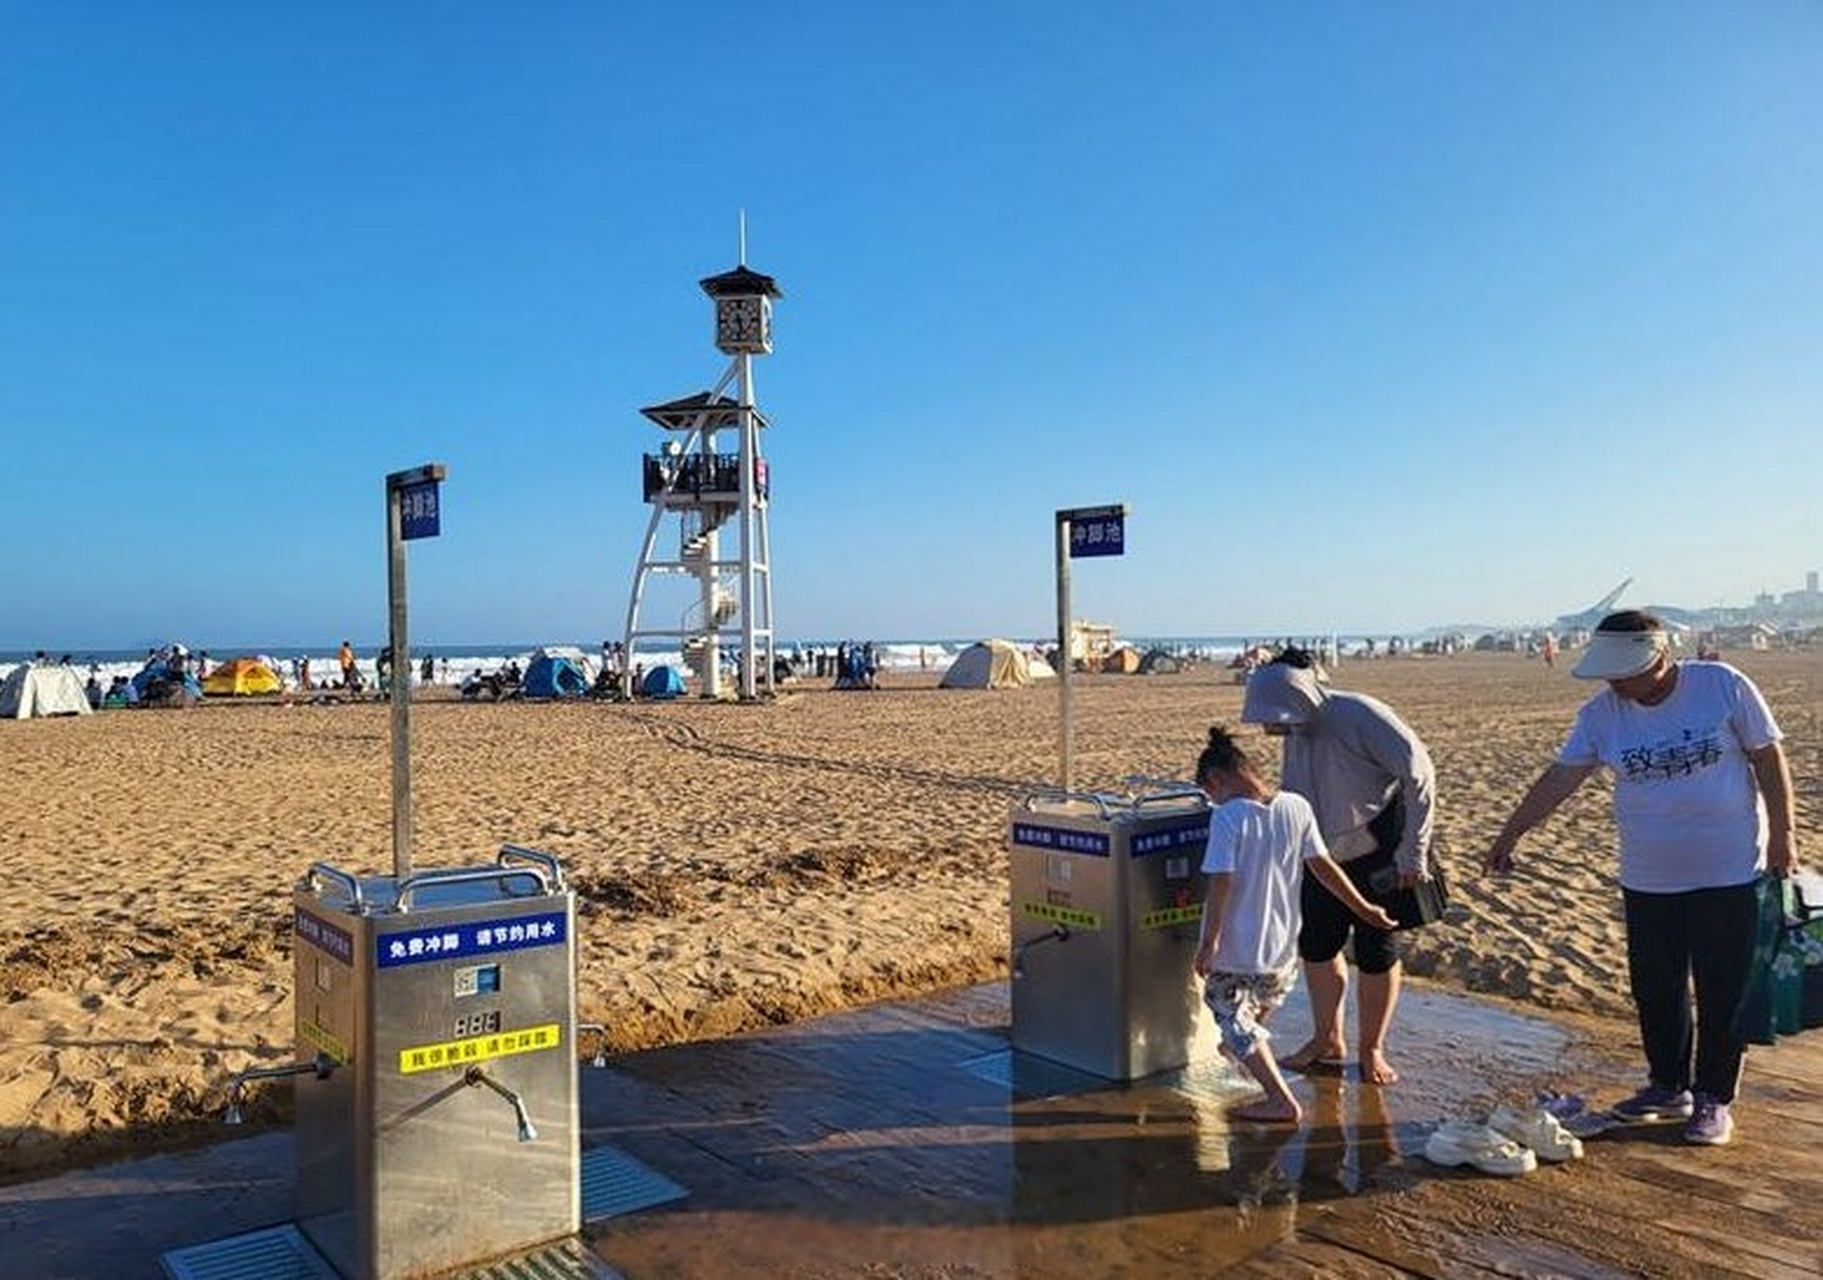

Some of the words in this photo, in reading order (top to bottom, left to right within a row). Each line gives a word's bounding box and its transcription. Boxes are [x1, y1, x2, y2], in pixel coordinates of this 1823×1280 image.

[389, 933, 460, 958] 免费冲脚
[476, 920, 556, 946] 请节约用水
